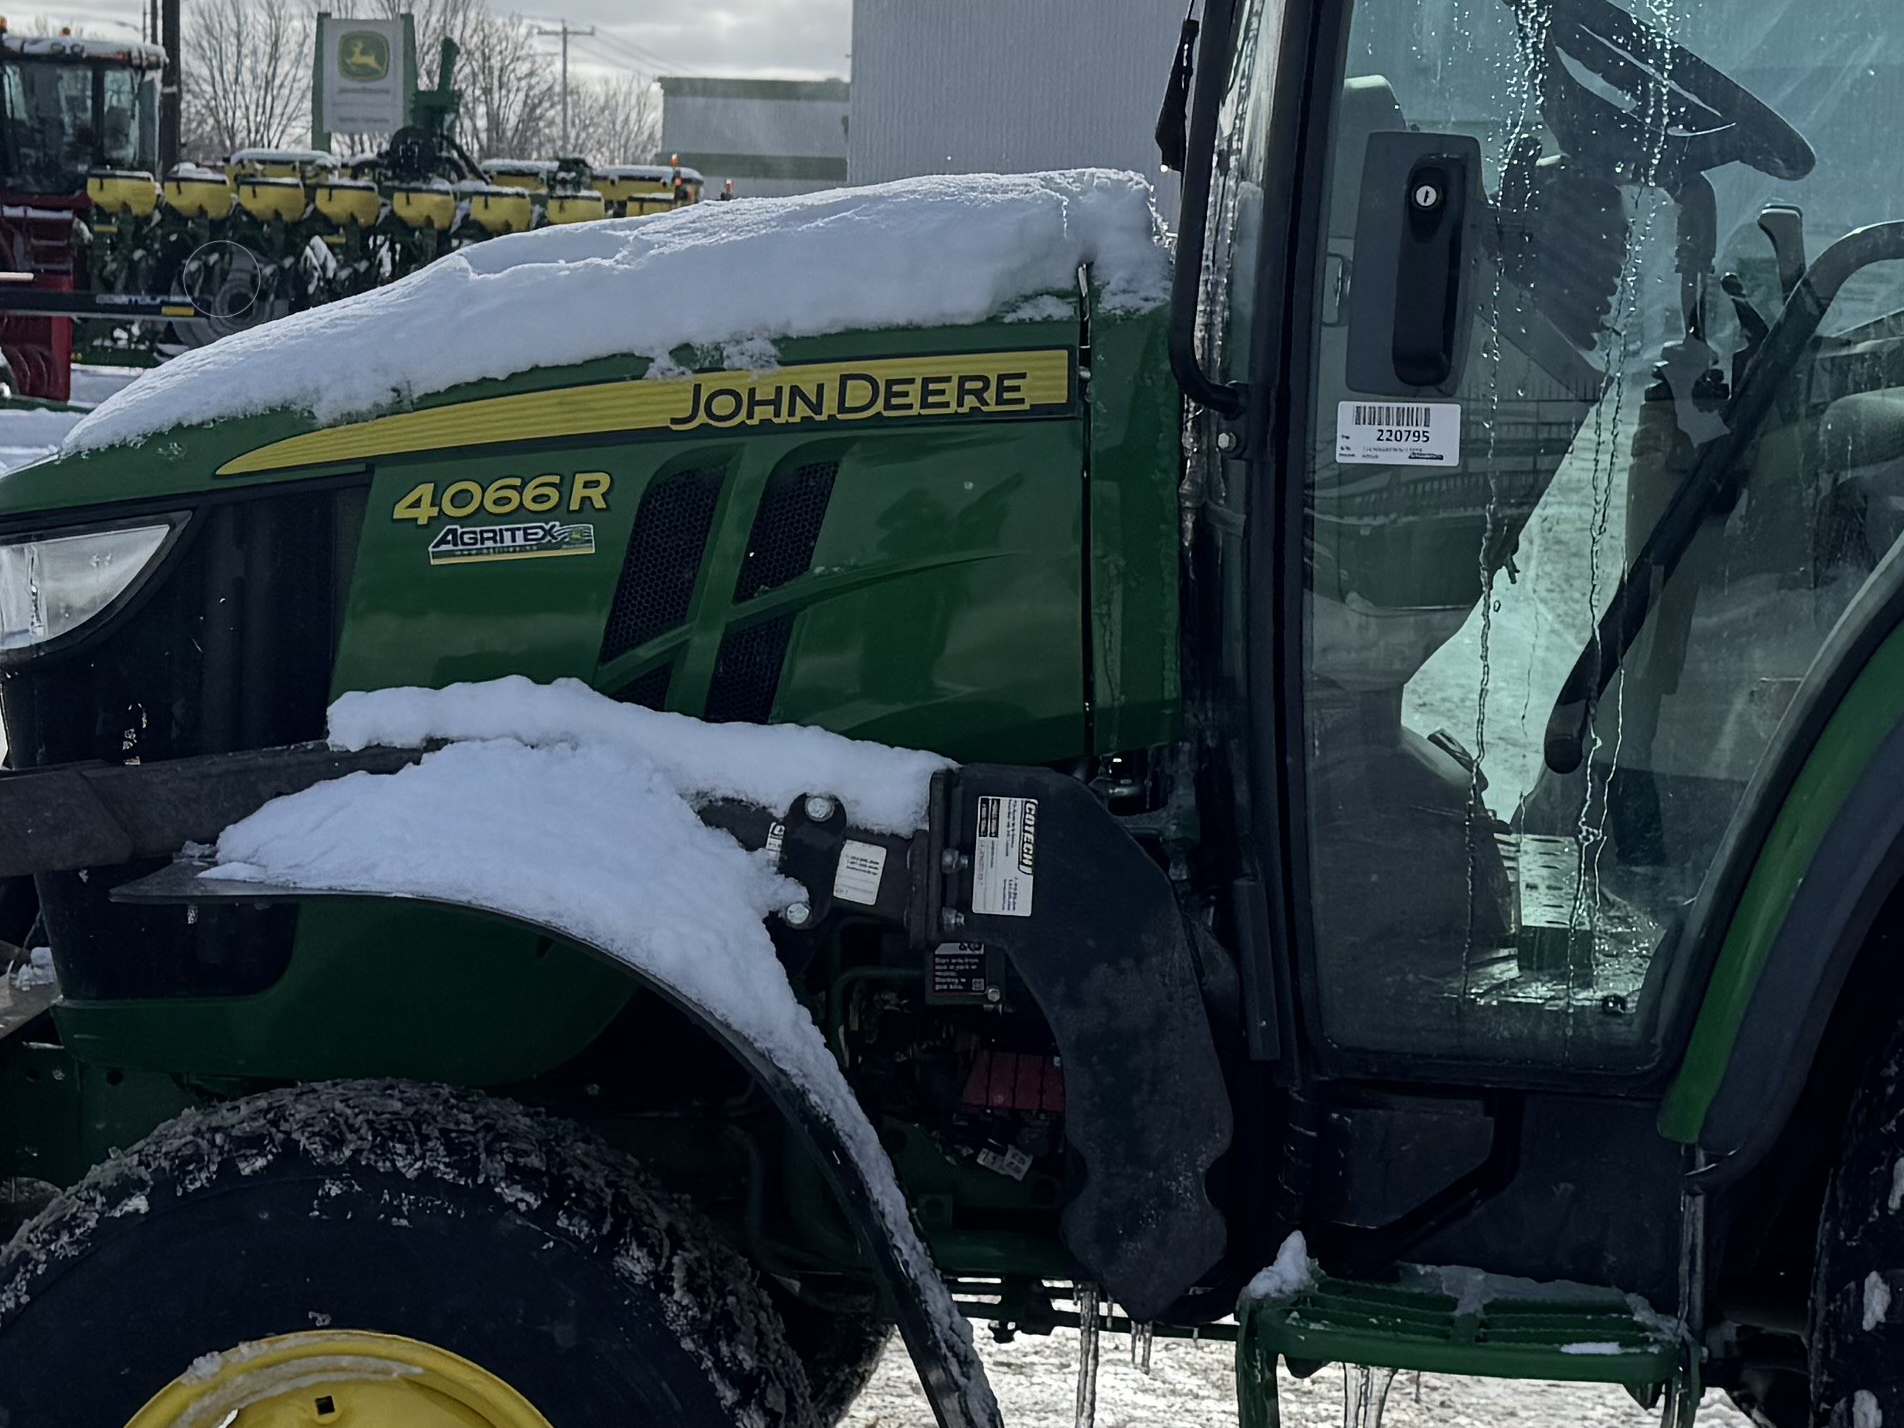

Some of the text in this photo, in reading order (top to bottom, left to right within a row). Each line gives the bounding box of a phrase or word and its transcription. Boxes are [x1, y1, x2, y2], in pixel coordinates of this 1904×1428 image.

[668, 371, 1028, 427] JOHN DEERE
[1376, 428, 1430, 443] 220795
[432, 523, 562, 549] AGRITEX
[1021, 802, 1036, 866] COTECH
